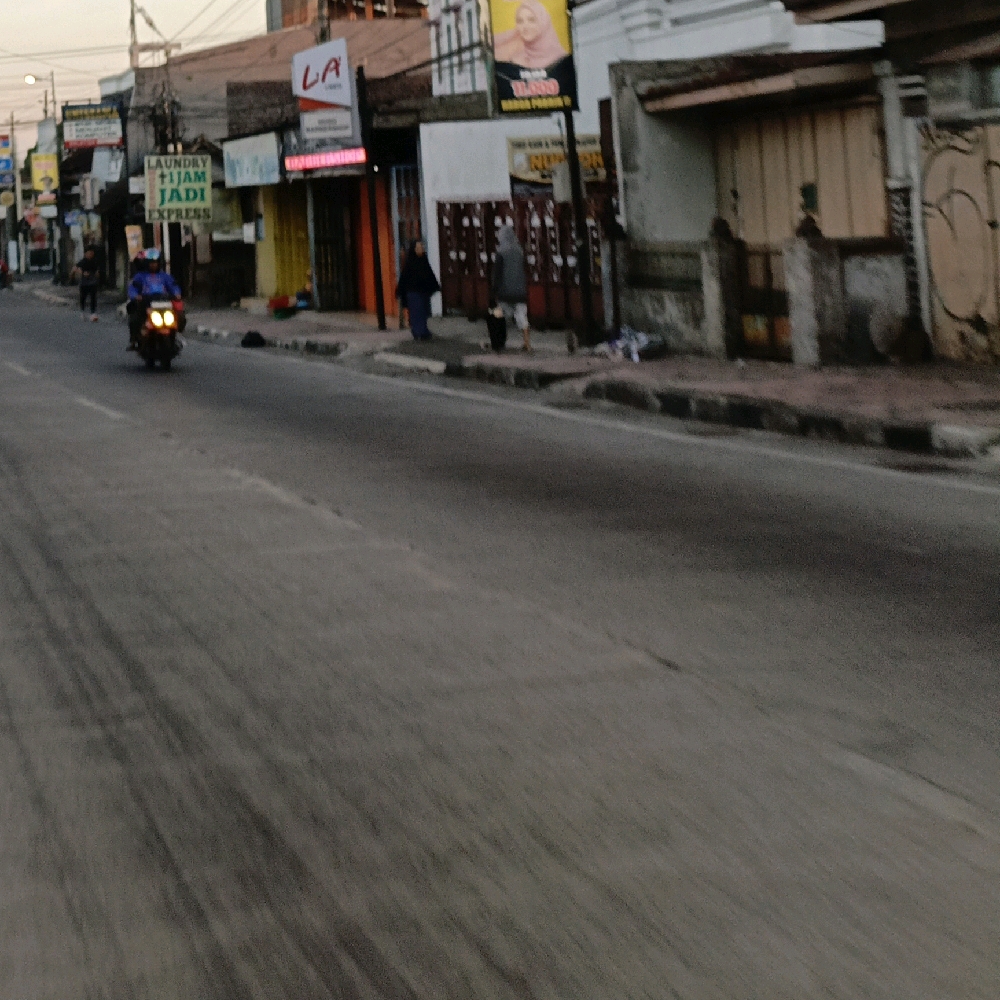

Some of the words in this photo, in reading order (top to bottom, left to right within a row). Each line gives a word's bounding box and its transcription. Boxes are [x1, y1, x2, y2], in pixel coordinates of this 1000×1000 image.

[301, 56, 342, 92] LA
[147, 157, 209, 170] LAUNDRY
[159, 187, 206, 206] JADI
[148, 207, 212, 220] EXPRESS
